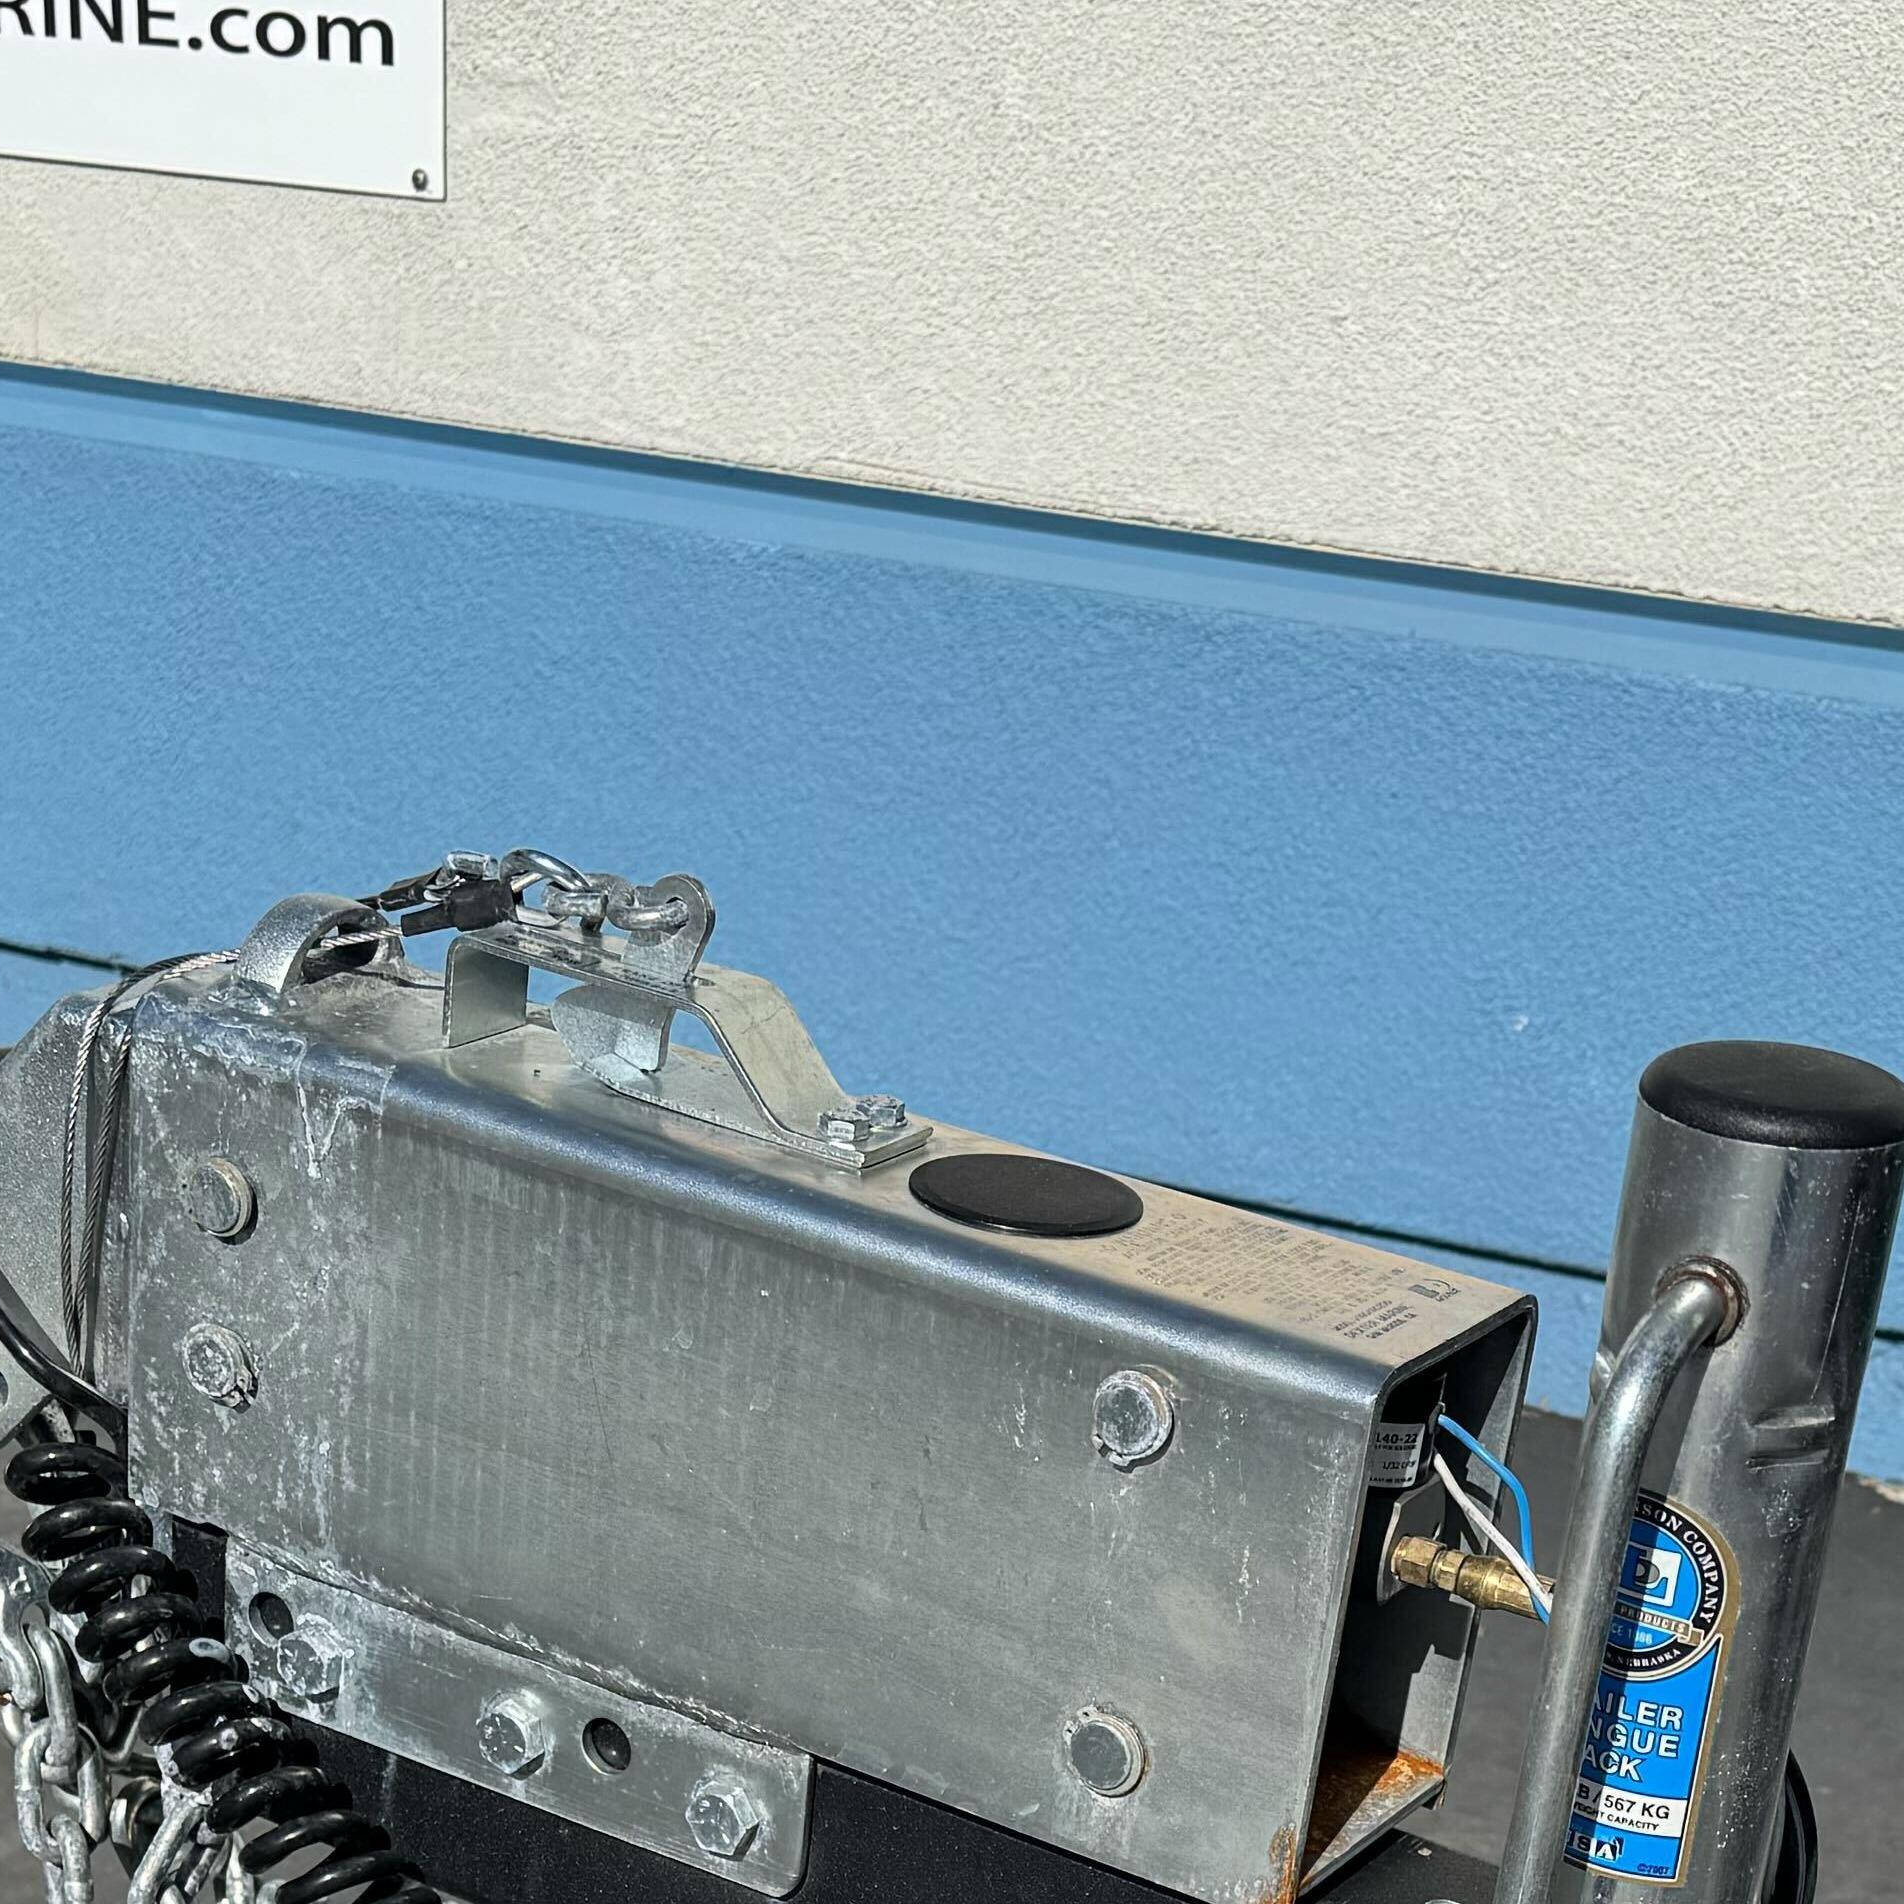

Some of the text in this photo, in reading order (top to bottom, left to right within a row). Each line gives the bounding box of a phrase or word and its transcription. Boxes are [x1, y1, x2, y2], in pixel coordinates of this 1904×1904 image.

[1632, 1503, 1719, 1624] SON COMPANY
[1619, 1607, 1686, 1633] PRODUCTS
[1596, 1692, 1683, 1731] ILER
[1590, 1718, 1679, 1758] NGUE
[1585, 1744, 1642, 1781] ACK
[1604, 1794, 1636, 1814] 567
[1642, 1802, 1670, 1820] KG
[1607, 1813, 1660, 1831] CAPACITY
